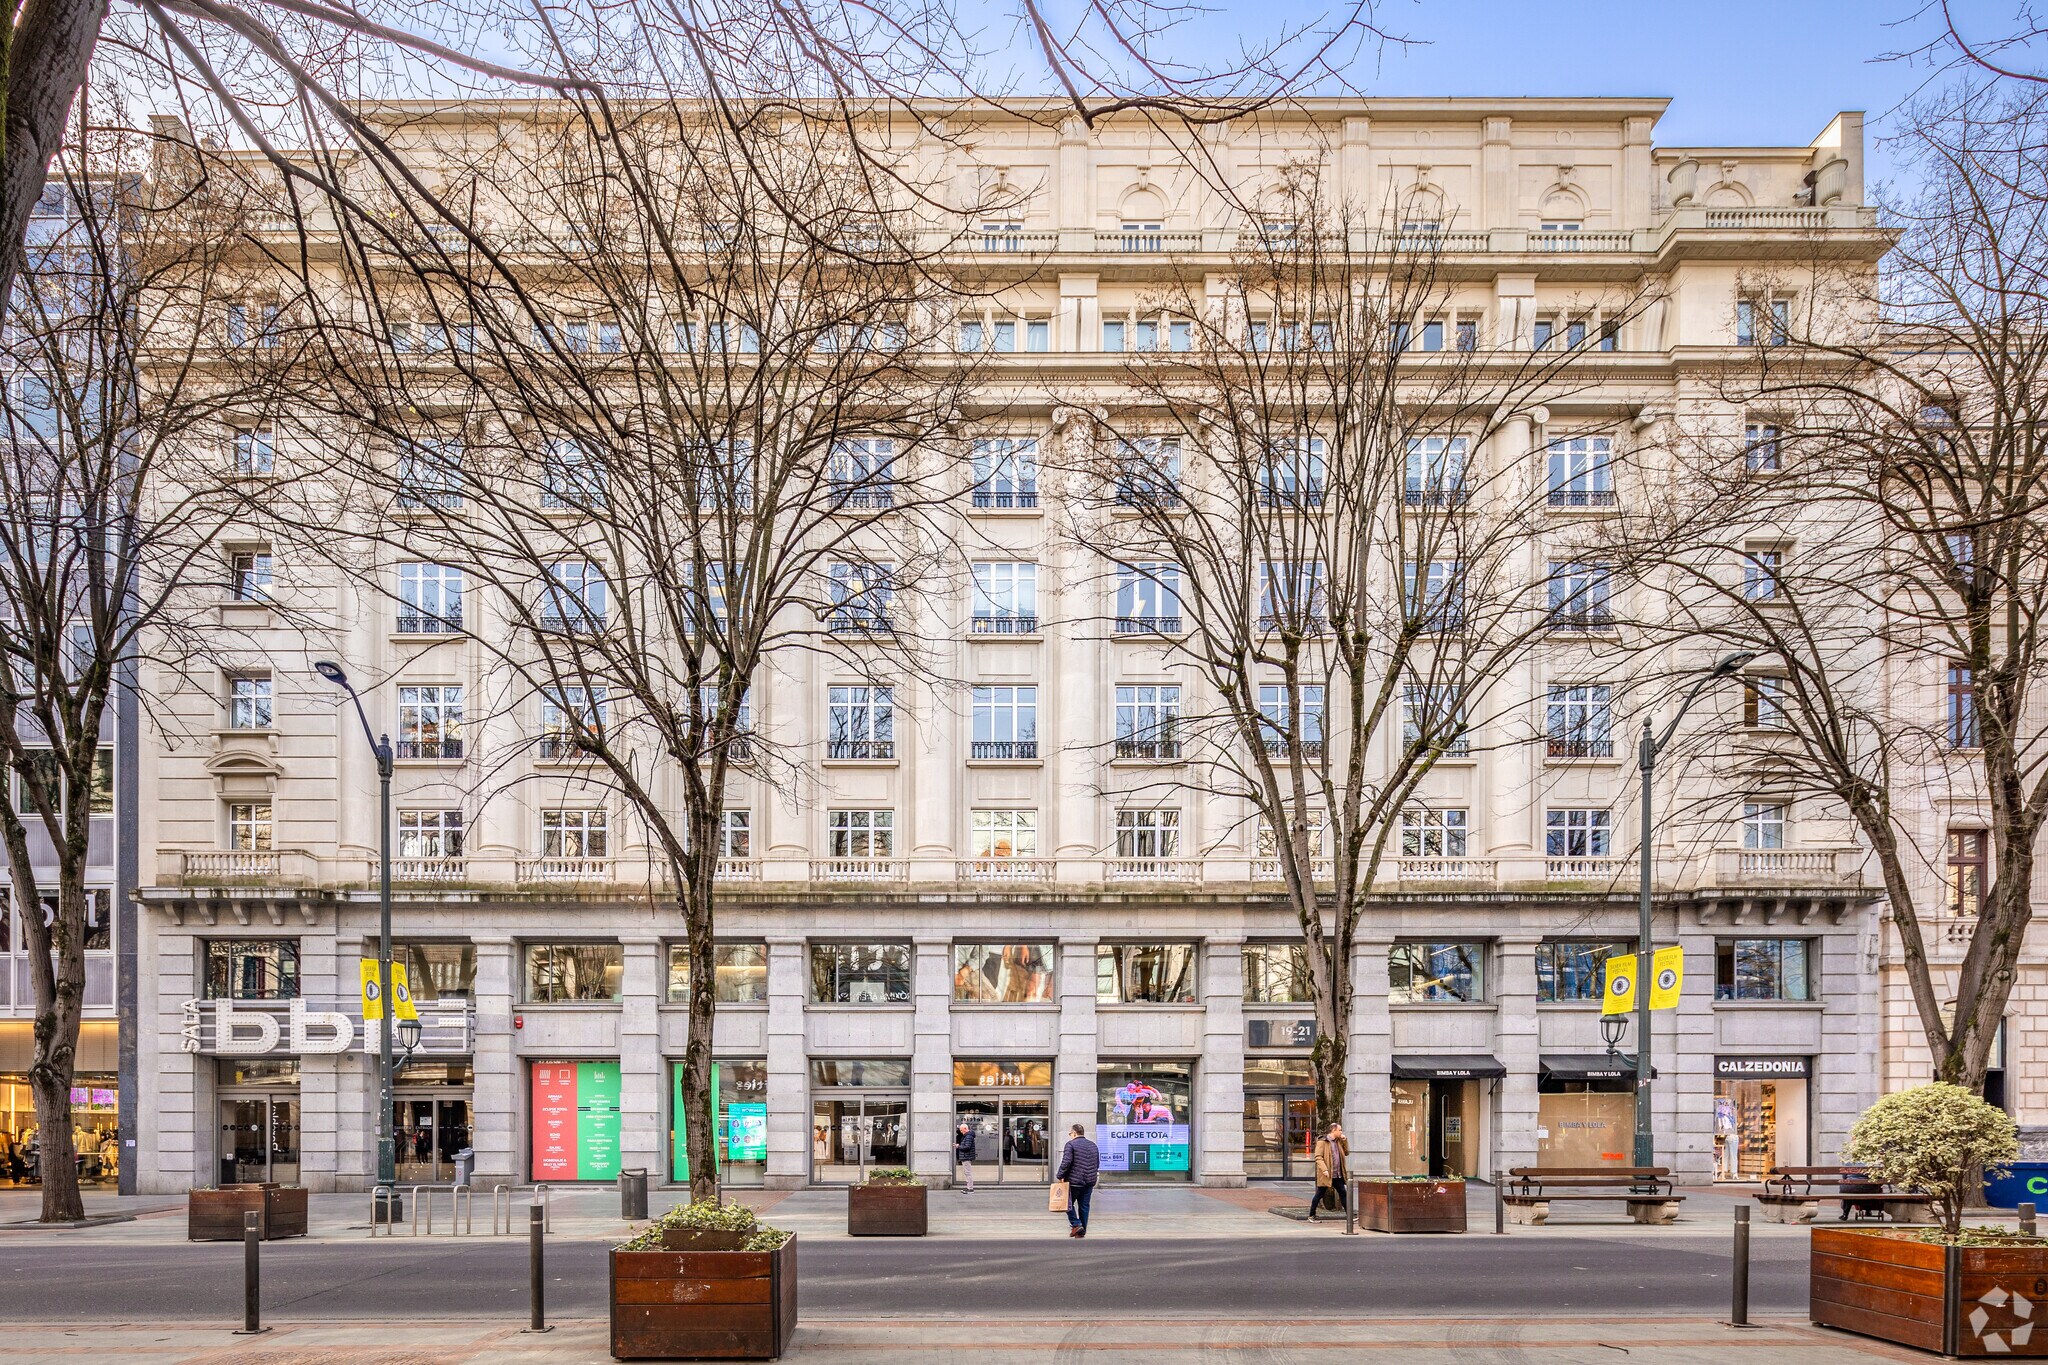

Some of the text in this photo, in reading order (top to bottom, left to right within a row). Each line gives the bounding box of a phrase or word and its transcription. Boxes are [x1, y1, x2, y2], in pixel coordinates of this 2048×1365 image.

[180, 998, 200, 1053] SALA
[1281, 1026, 1311, 1036] 19-21
[1718, 1060, 1806, 1072] CALZEDONIA
[1558, 1121, 1581, 1129] BIMBA
[1588, 1121, 1607, 1129] LOLA
[1110, 1131, 1173, 1139] ECLIPSE TOTA
